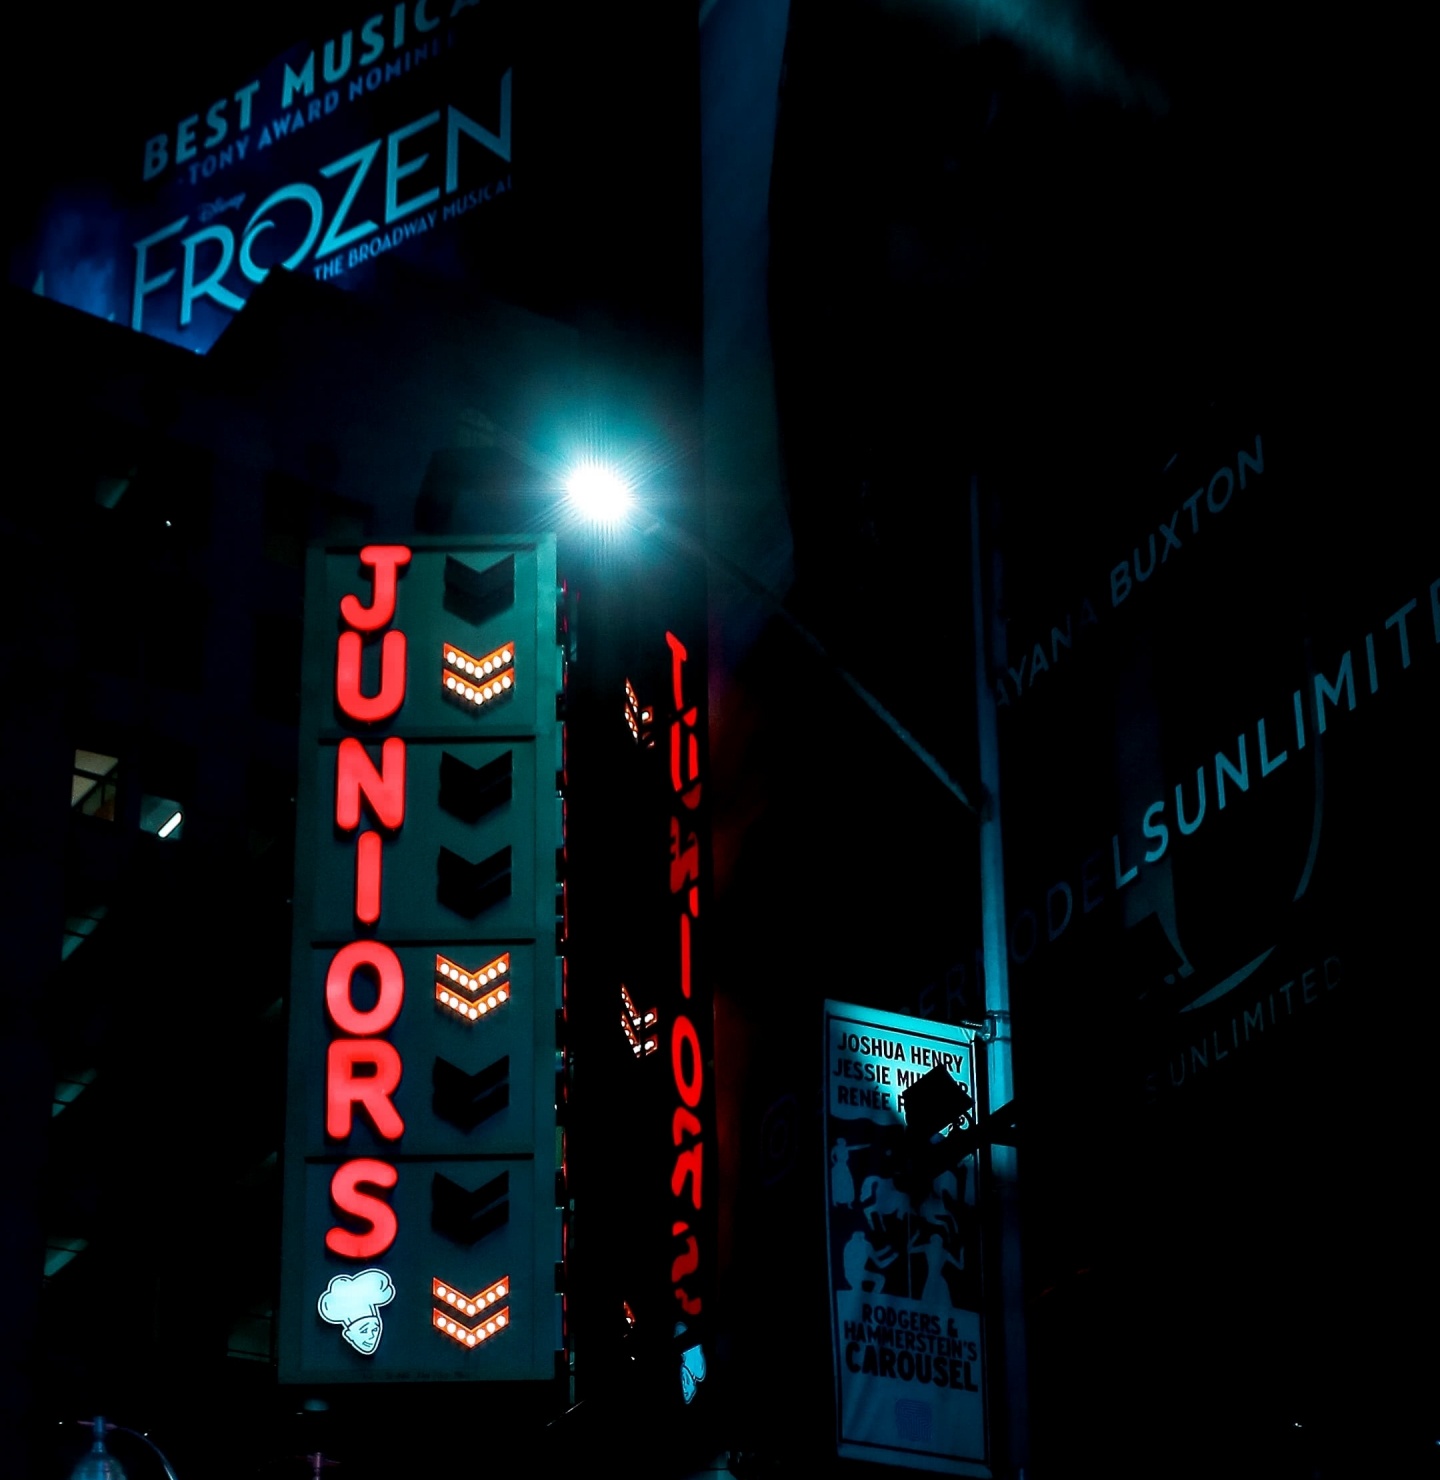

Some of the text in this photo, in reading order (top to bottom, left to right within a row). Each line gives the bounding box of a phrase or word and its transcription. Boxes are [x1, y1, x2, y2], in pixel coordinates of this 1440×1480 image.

[142, 78, 261, 182] BEST
[187, 133, 250, 187] TONY
[257, 87, 341, 151] AWARD
[132, 65, 514, 334] FROZEN
[313, 253, 345, 281] THE
[348, 207, 438, 269] BROADWAY
[1108, 430, 1266, 610] BUXTON
[321, 542, 413, 1263] JUNIORS
[838, 1032, 964, 1074] JOSHUA HENRY
[1166, 951, 1343, 1090] UNLIMITED
[833, 1057, 892, 1087] JESSIE
[844, 1319, 978, 1362] HAMMERSTEIN'S
[862, 1303, 958, 1338] RODGERS &
[846, 1342, 979, 1393] CAROUSEL
